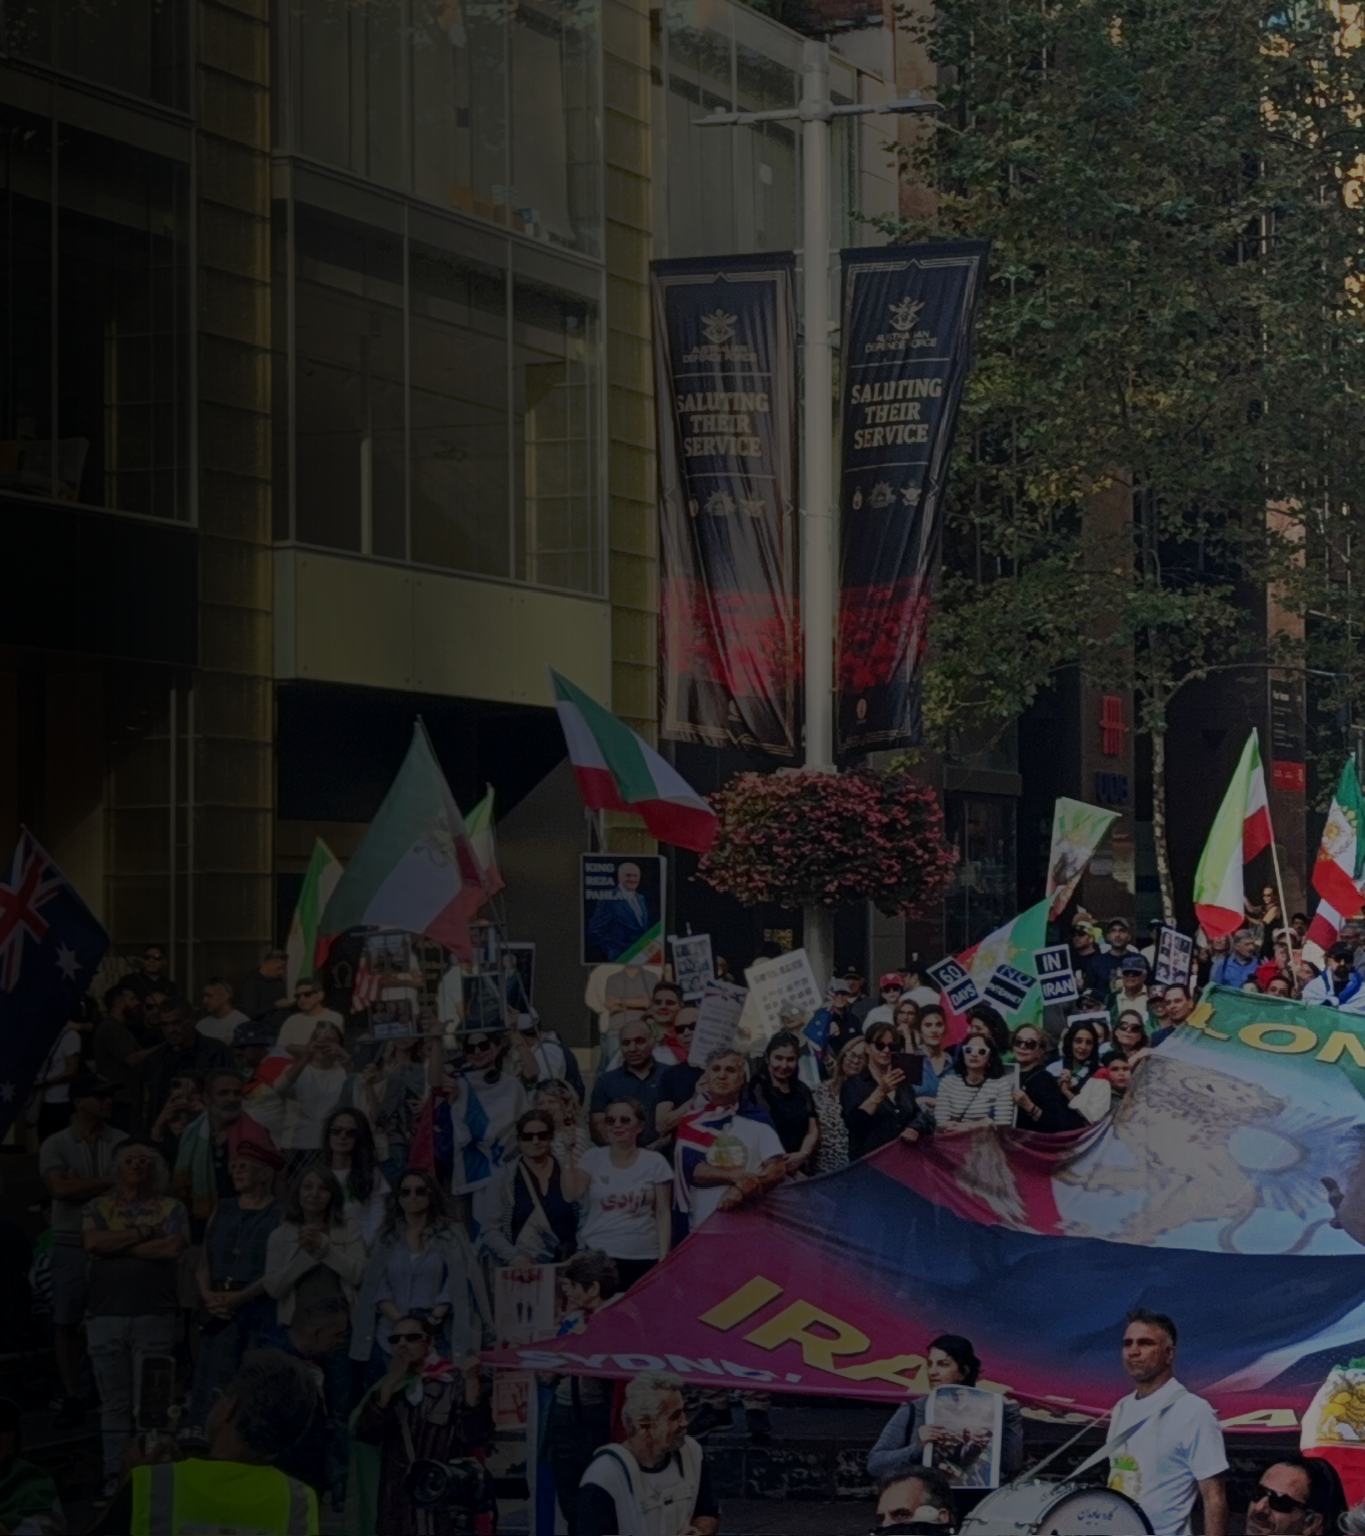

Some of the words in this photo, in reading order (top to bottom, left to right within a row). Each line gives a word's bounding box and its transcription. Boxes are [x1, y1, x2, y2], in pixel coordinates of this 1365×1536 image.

[676, 391, 769, 413] SALUTING
[851, 378, 942, 404] SALUTING
[690, 414, 752, 433] THEIR
[865, 402, 921, 424] THEIR
[684, 435, 762, 457] SERVICE
[854, 424, 929, 449] SERVICE
[1042, 952, 1061, 972] IN
[939, 965, 961, 983] 60
[999, 966, 1032, 985] NO
[951, 983, 976, 1006] DAYS
[1043, 978, 1074, 997] IRAN
